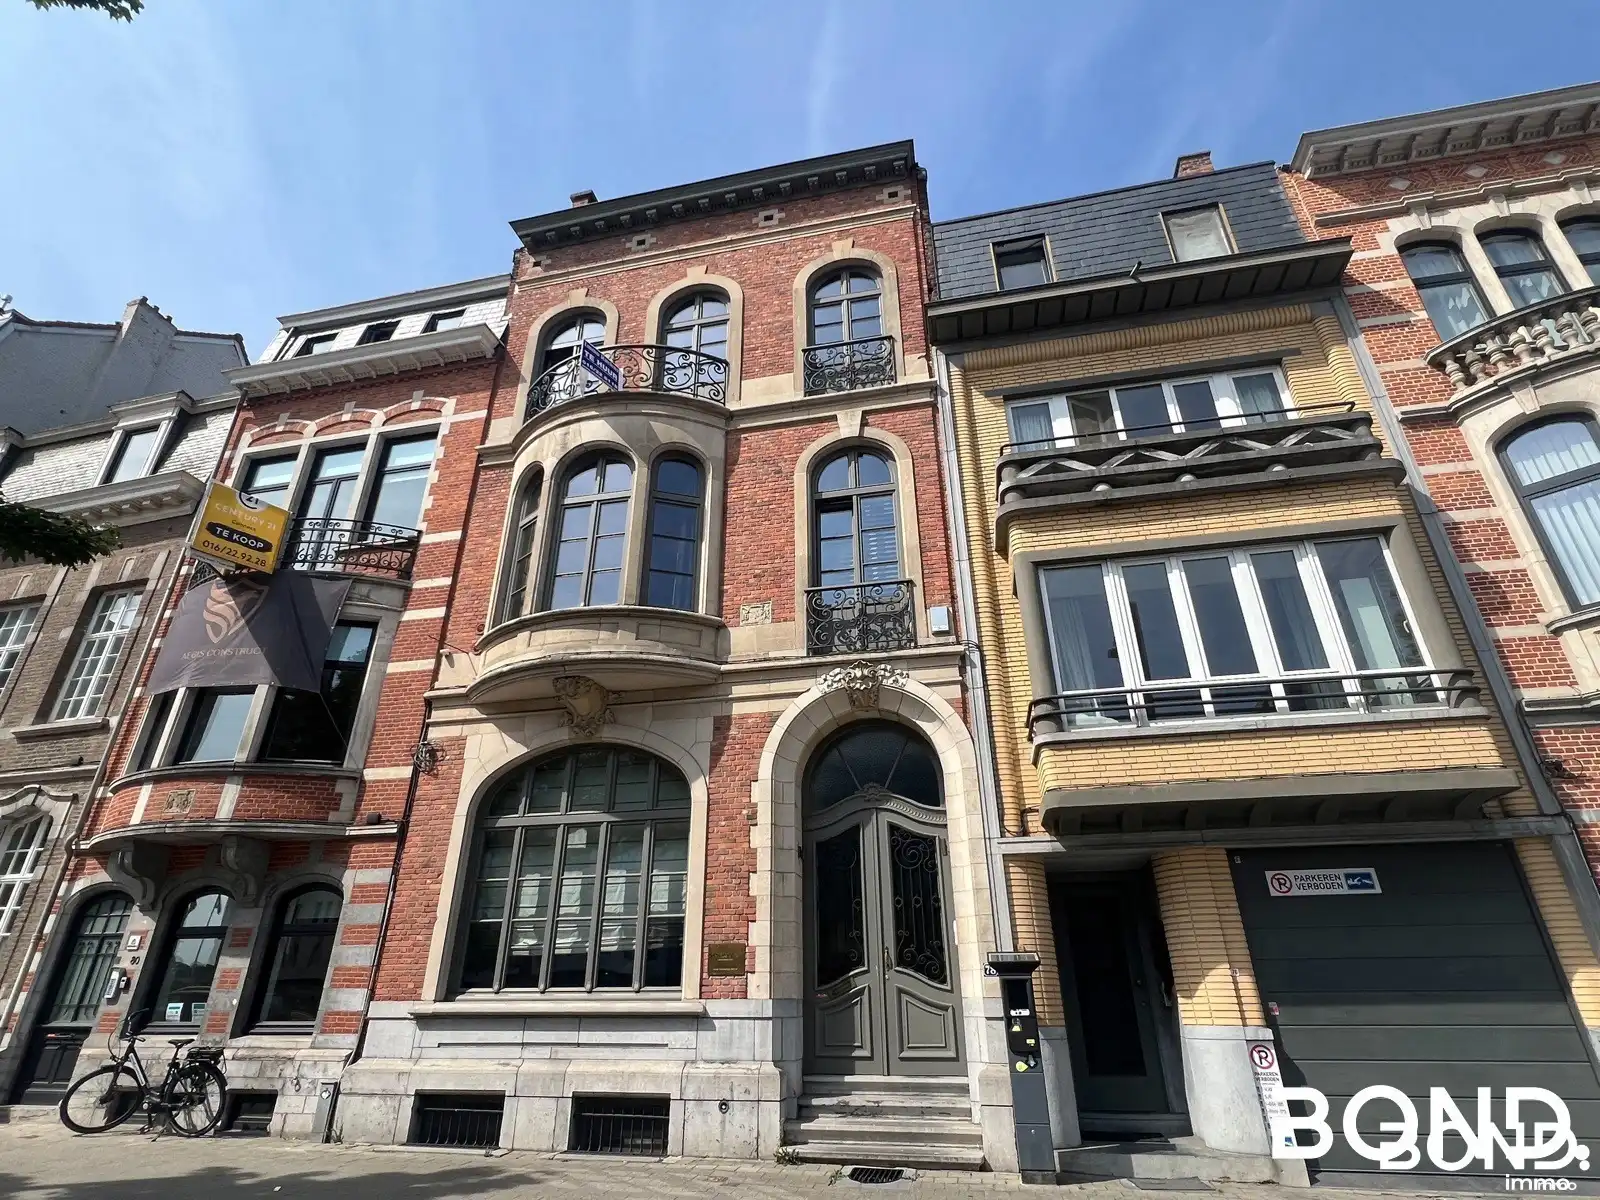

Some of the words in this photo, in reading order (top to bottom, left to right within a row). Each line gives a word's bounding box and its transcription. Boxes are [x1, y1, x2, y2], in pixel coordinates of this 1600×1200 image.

[584, 350, 595, 362] TE
[597, 359, 618, 381] HUUR
[215, 503, 265, 526] CENTURY
[267, 521, 277, 531] 21
[215, 526, 230, 538] TE
[232, 533, 264, 549] KOOP
[202, 540, 267, 567] 016/22.92.28
[181, 650, 205, 660] AEGIS
[206, 647, 268, 657] CONSTRUCT
[1293, 873, 1341, 882] PARKEREN
[1295, 882, 1344, 891] VERBODEN
[130, 956, 141, 966] 80
